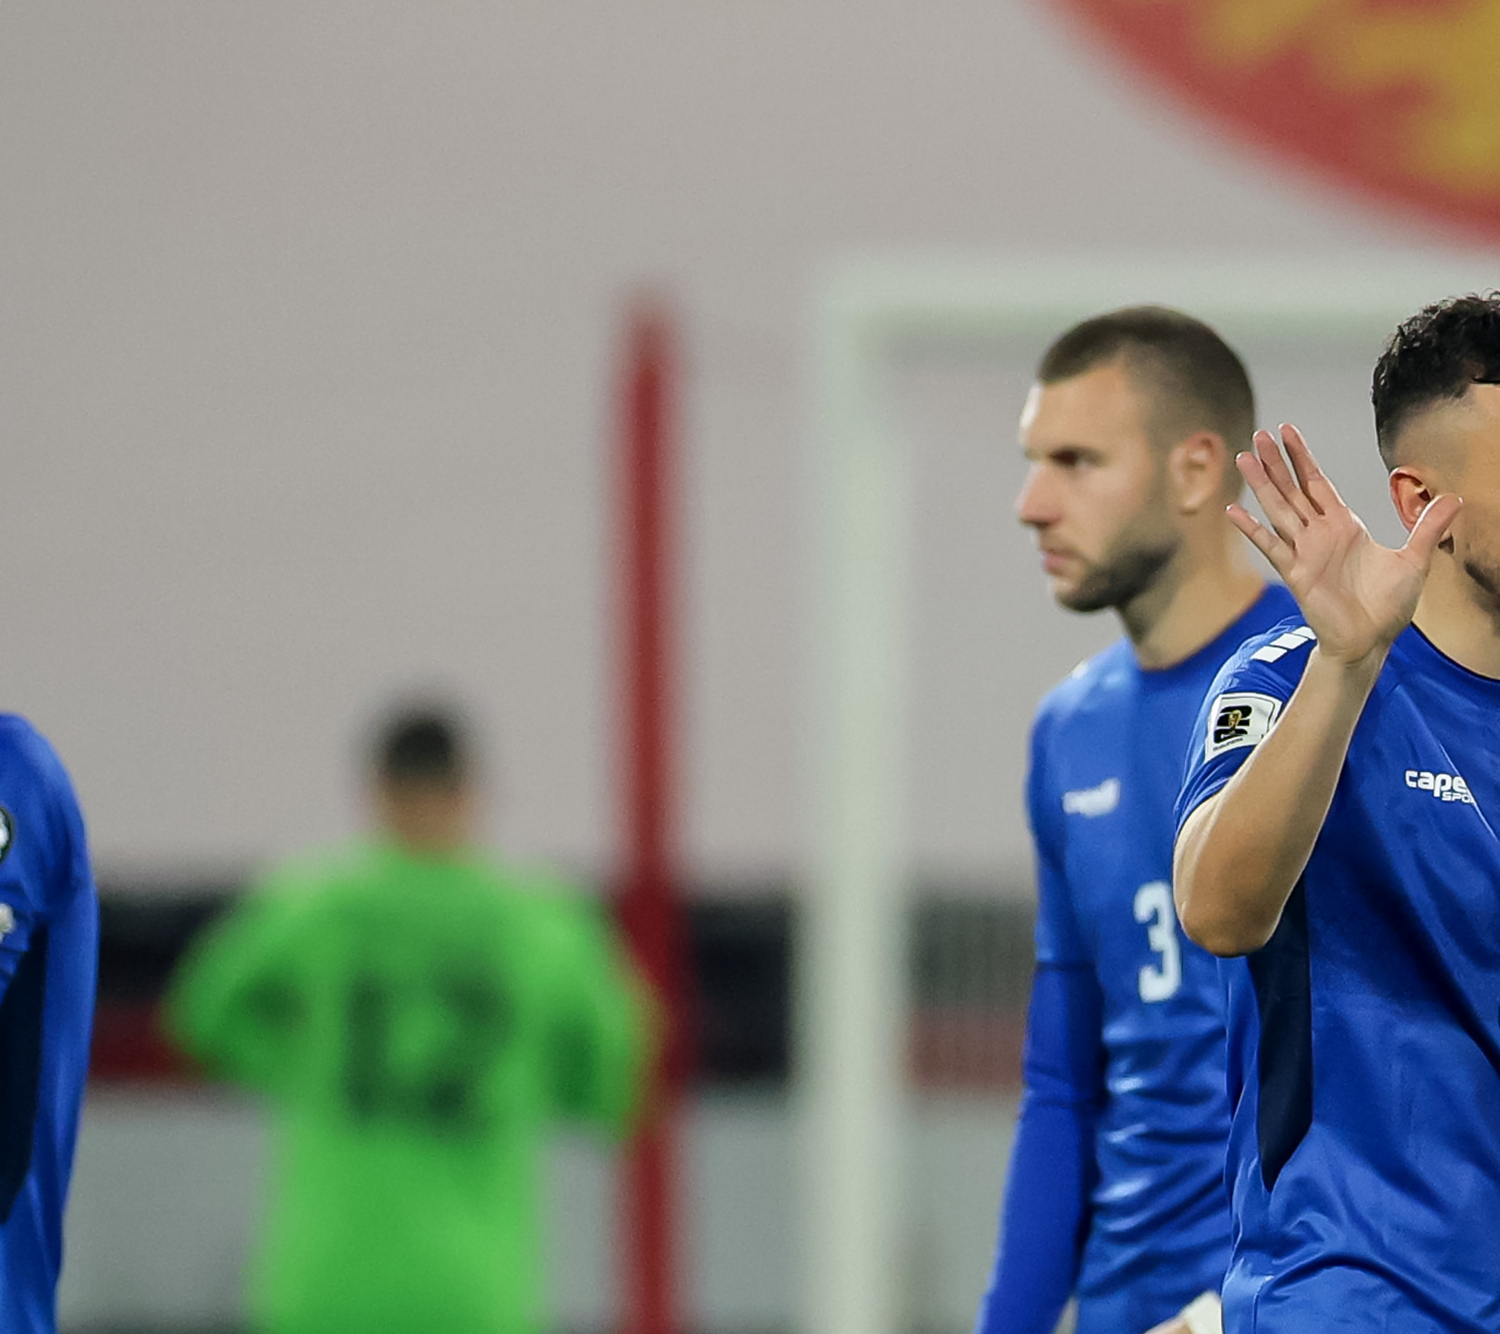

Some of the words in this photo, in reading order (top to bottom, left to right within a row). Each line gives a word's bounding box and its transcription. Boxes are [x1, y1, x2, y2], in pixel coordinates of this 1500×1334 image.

[1405, 770, 1468, 797] cape
[1441, 791, 1476, 804] SPO
[1133, 881, 1182, 1004] 3
